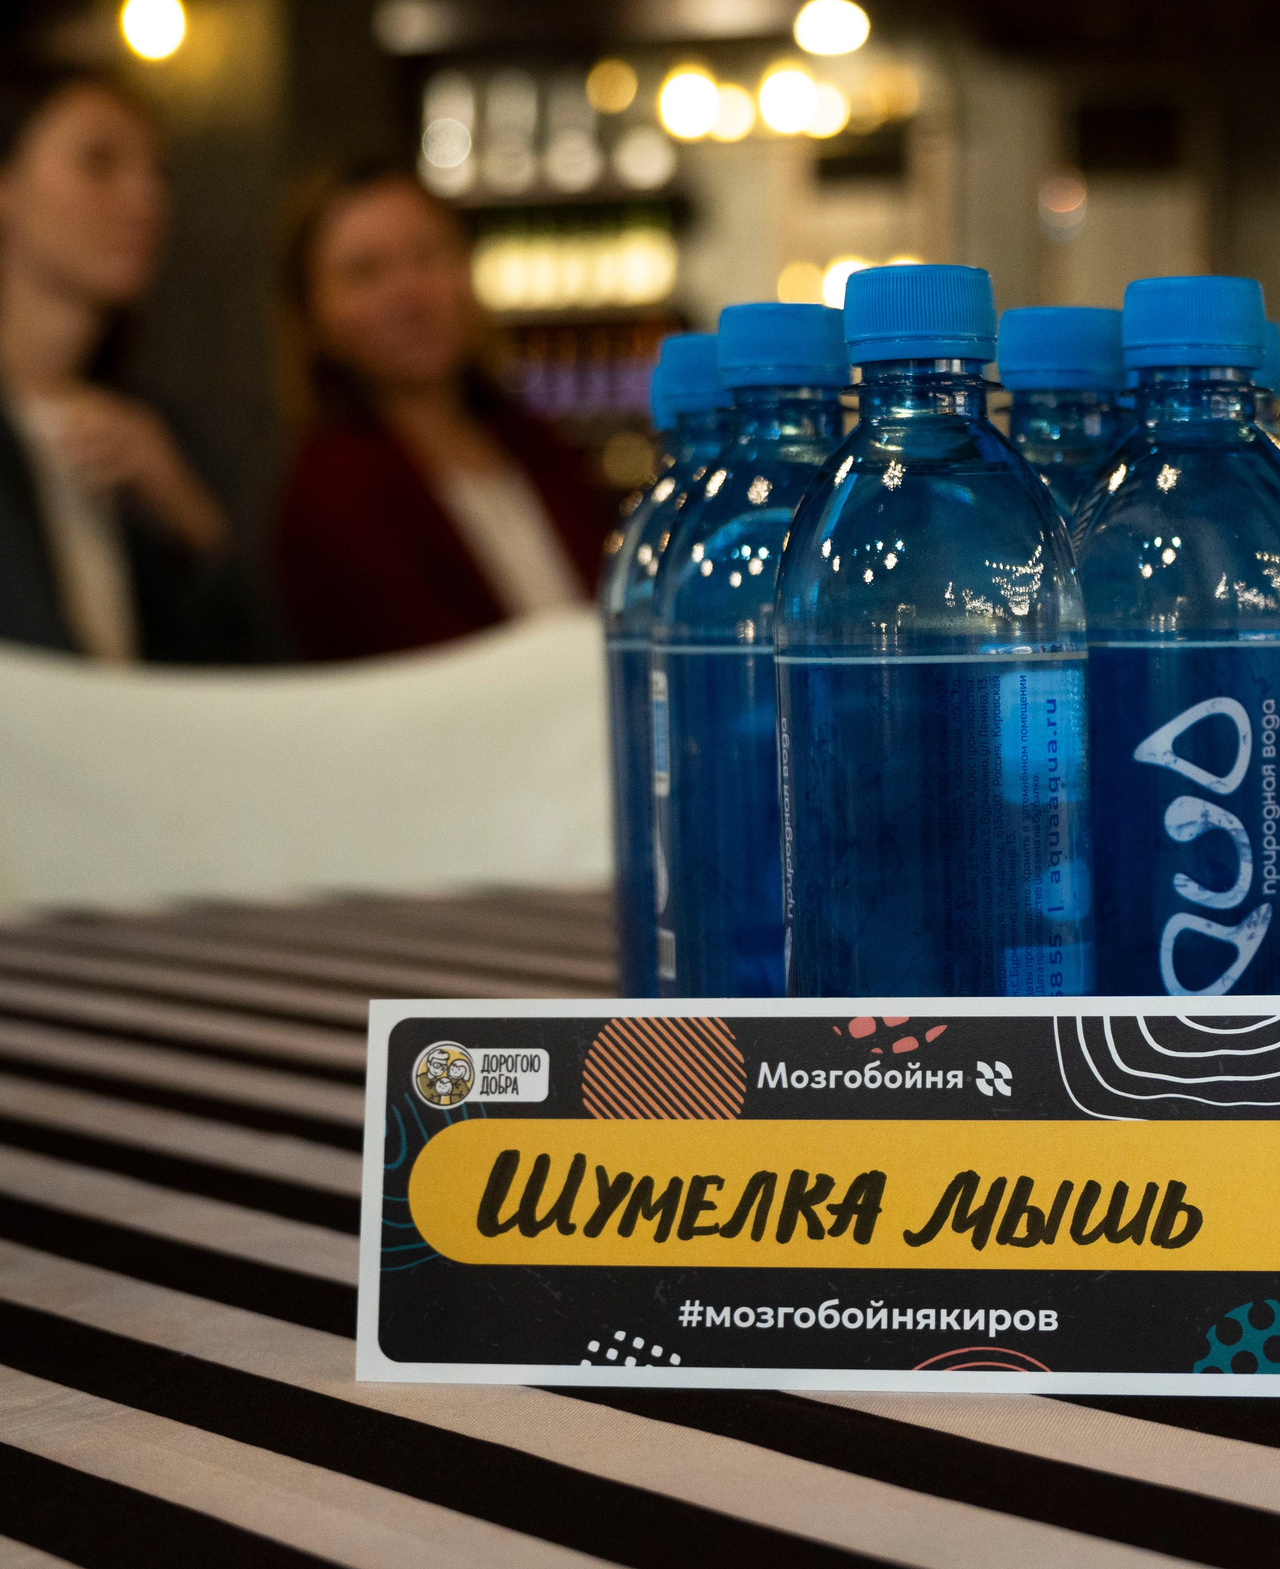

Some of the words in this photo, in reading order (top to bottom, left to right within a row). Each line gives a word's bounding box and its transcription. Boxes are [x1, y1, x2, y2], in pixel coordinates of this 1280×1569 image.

[992, 675, 1003, 737] Кировская
[1020, 675, 1028, 742] помещении
[1262, 699, 1280, 757] вода
[1046, 698, 1062, 884] aquaaqua.ru
[1262, 764, 1280, 895] природная
[479, 1076, 520, 1096] ДОБРА
[481, 1053, 541, 1074] ДОРОГОЮ
[757, 1060, 963, 1089] Мозгобойня
[476, 1149, 888, 1245] ШУМЕЛКА
[903, 1169, 1203, 1250] МЫШЬ
[678, 1300, 1059, 1336] #мозгобойнякиров
